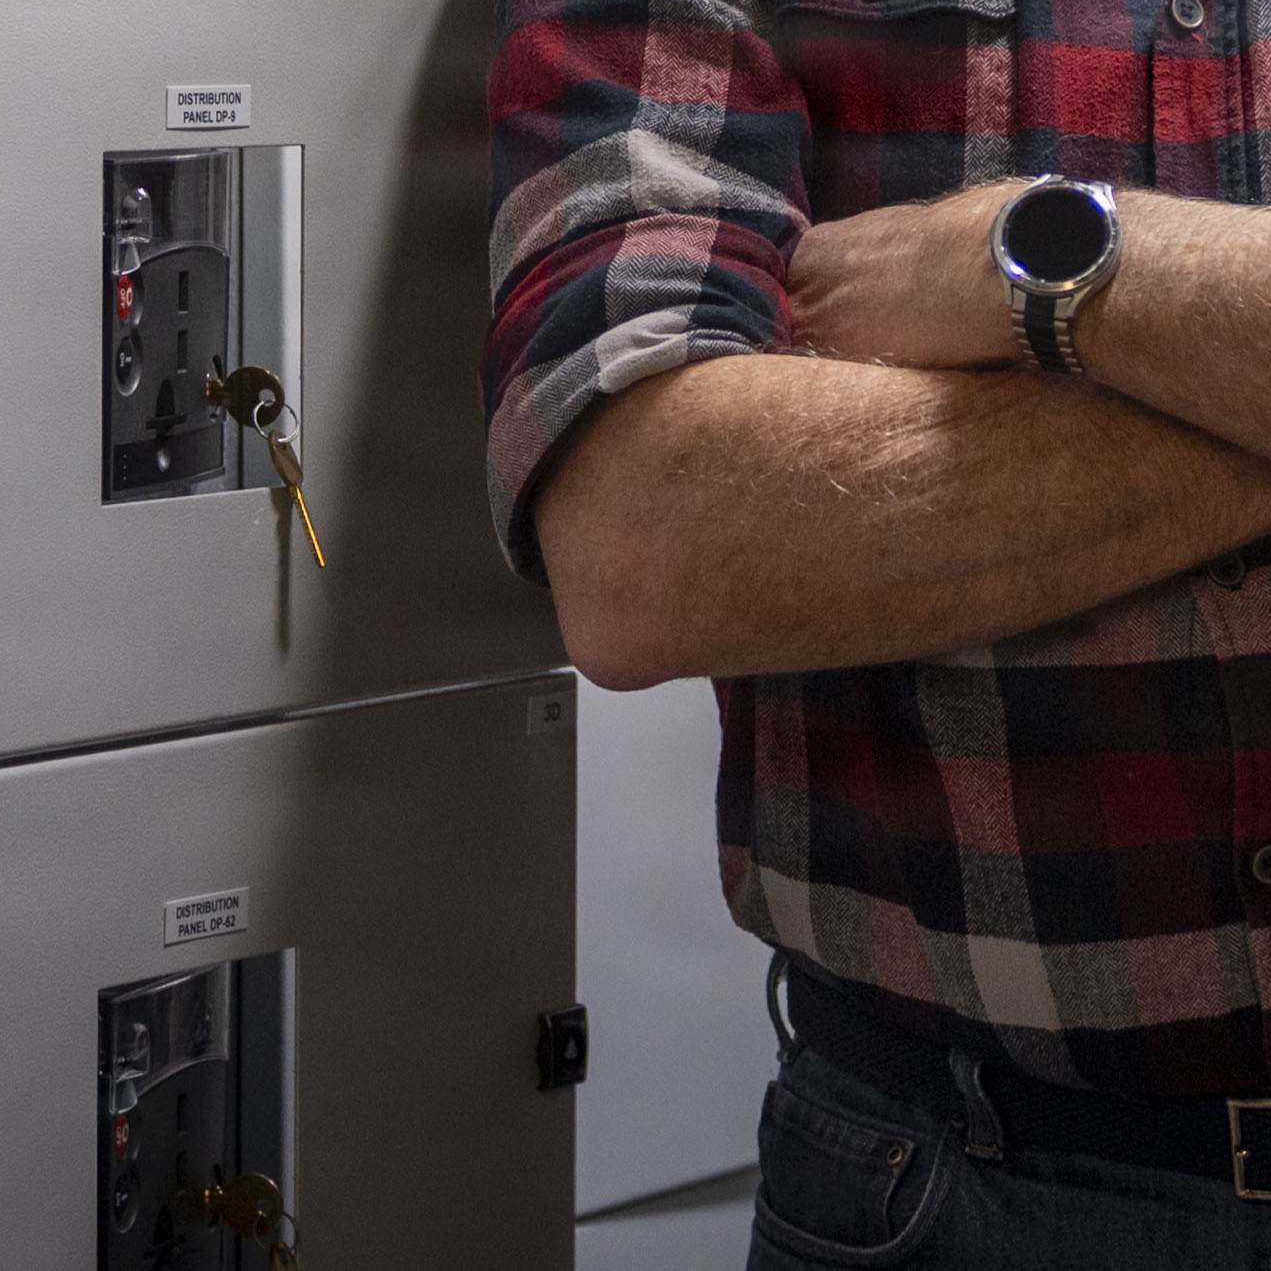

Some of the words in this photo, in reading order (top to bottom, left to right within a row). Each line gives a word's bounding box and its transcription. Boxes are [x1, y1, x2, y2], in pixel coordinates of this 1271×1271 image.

[178, 92, 241, 105] DISTRIBUTION
[183, 111, 214, 123] PANEL
[216, 110, 236, 122] DP-9
[176, 896, 239, 919] DISTRIBUTION
[178, 921, 208, 937] PANEL
